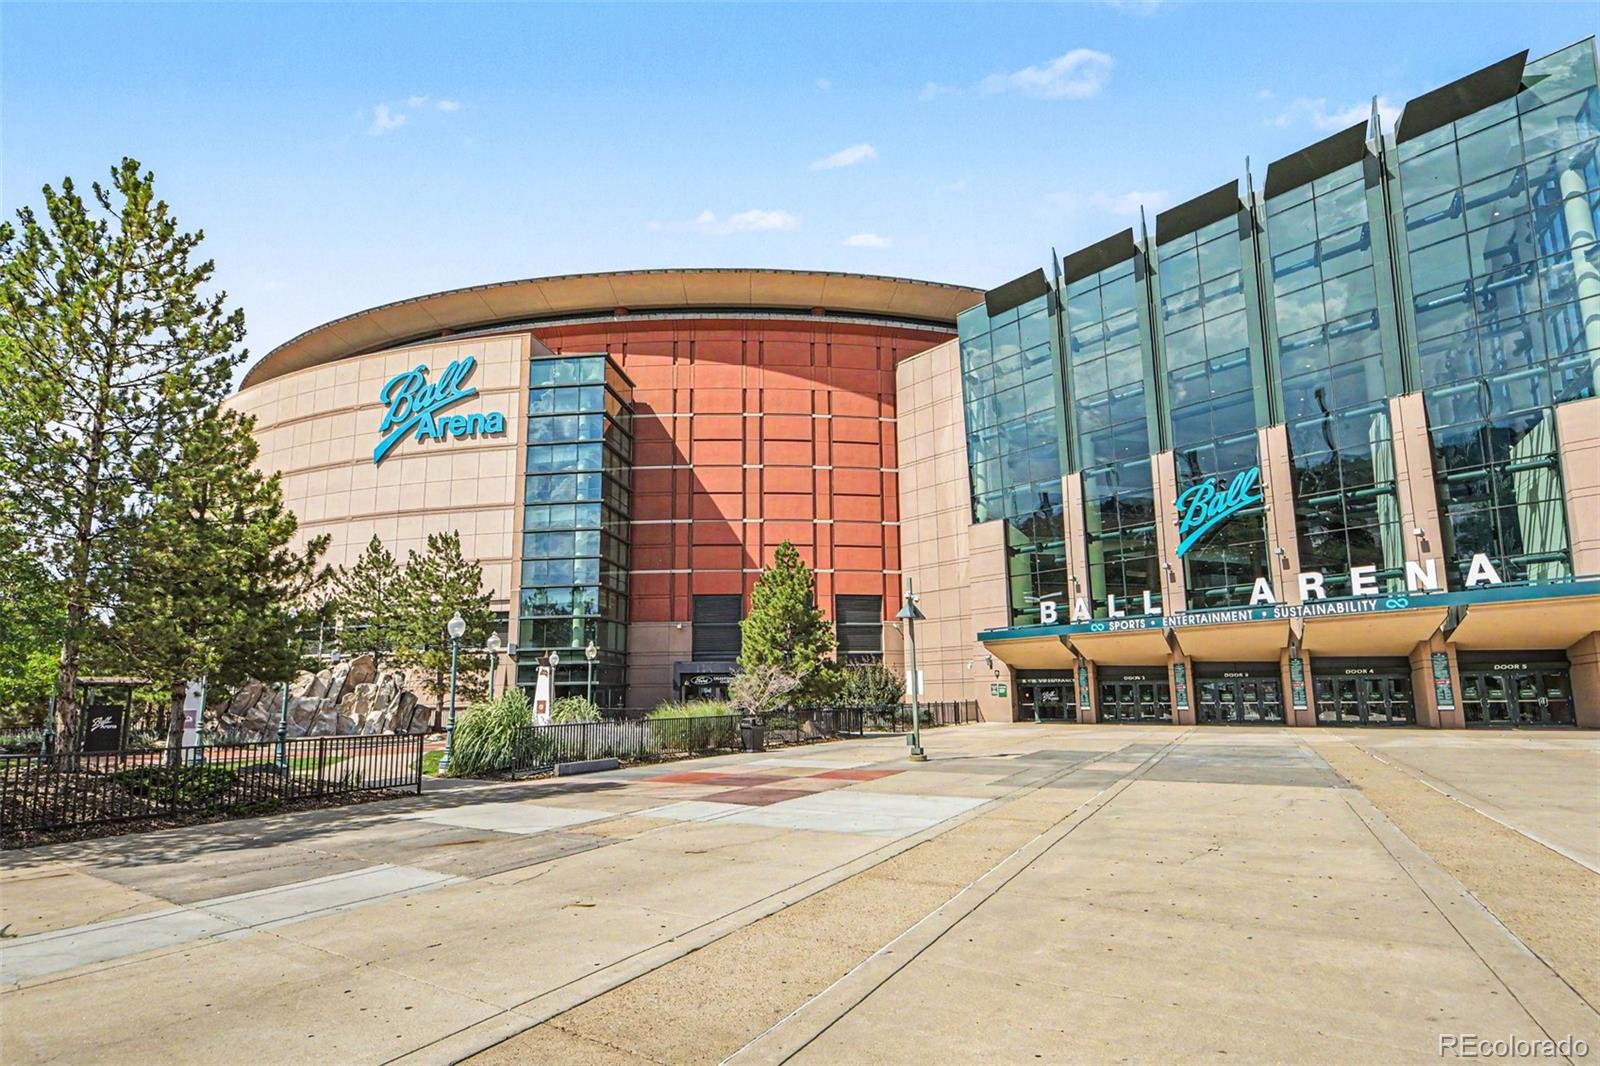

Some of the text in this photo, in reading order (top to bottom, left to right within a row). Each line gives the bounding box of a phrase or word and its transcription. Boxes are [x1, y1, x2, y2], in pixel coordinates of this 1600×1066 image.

[374, 356, 477, 464] Ball
[415, 411, 503, 440] Arena
[1176, 467, 1264, 559] Ball
[1040, 553, 1503, 625] BALL ARENA
[1109, 599, 1378, 631] SPORTS ENTERTAINMENT SUSTAINABILITY
